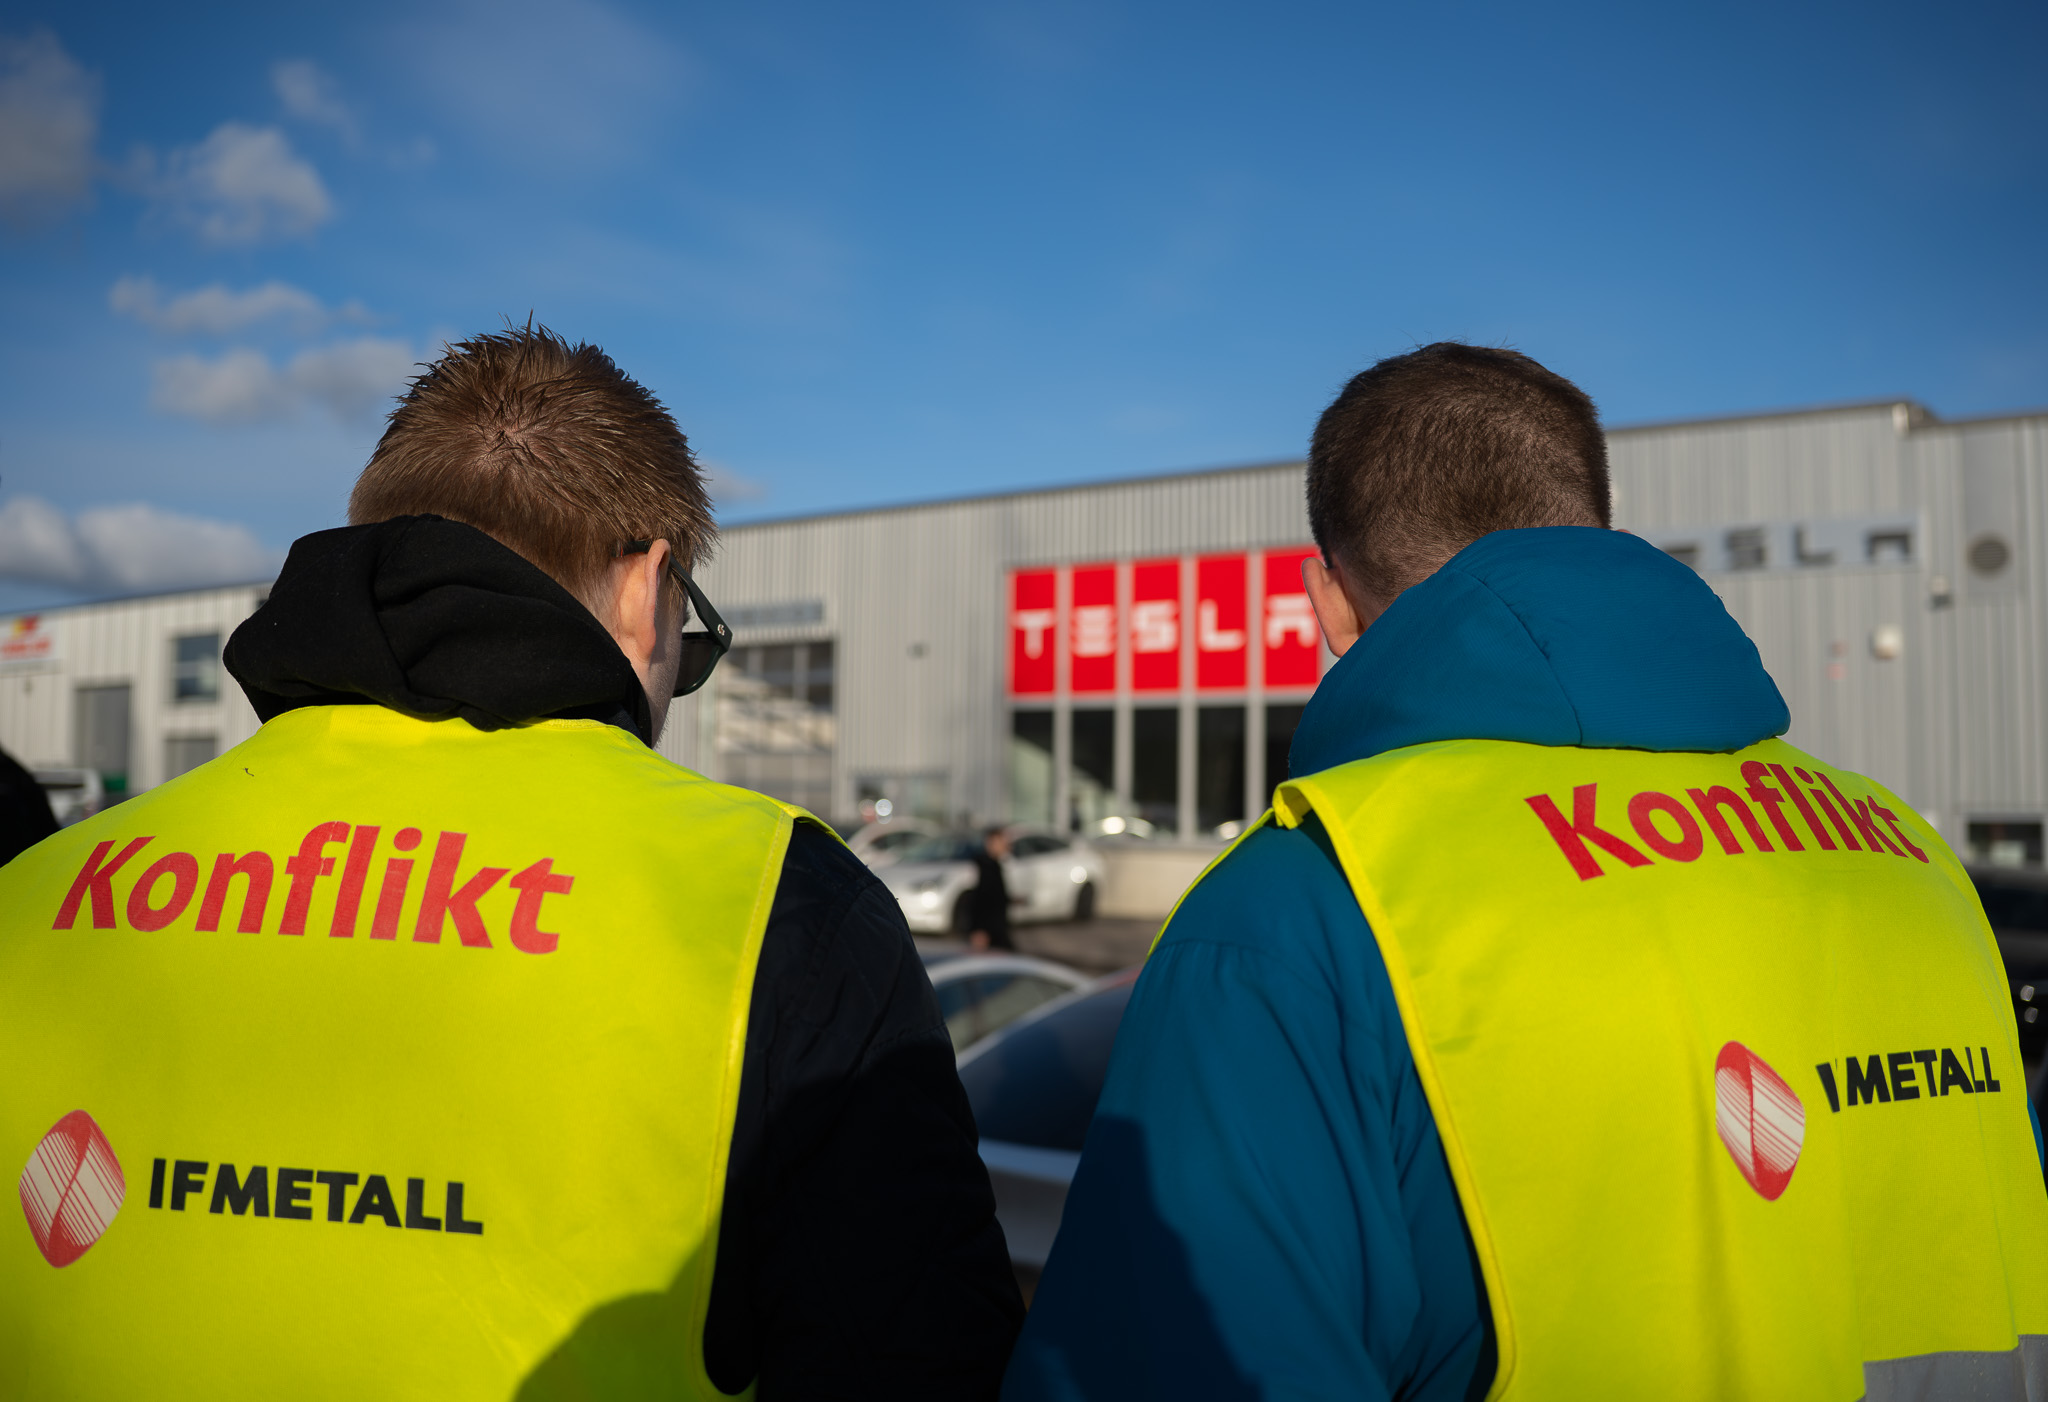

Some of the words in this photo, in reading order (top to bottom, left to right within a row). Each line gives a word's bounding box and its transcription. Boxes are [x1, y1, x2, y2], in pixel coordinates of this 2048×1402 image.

[1010, 592, 1316, 660] TESLA
[1523, 760, 1930, 882] Konflikt
[51, 820, 576, 955] Konflikt
